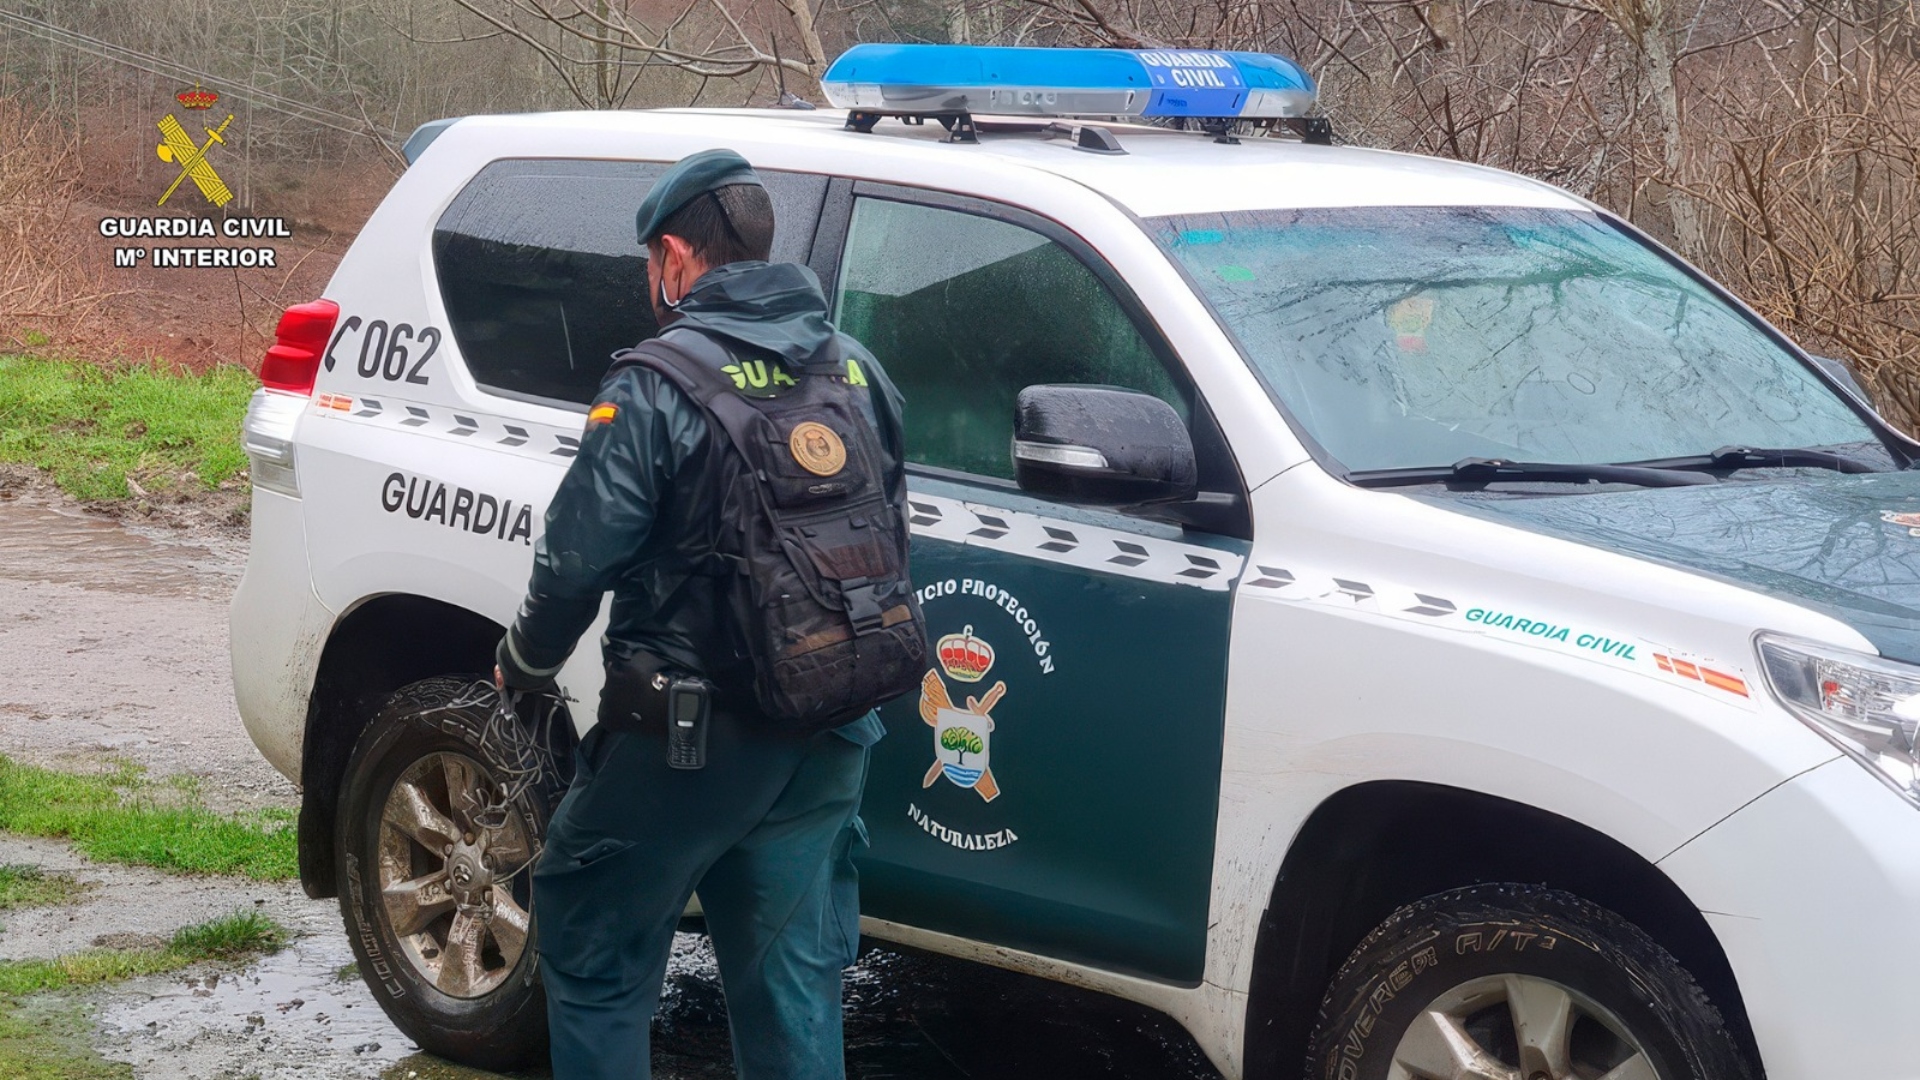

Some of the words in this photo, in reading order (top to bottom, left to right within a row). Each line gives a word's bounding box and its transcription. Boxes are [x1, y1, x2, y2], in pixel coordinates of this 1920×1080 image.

[1139, 52, 1232, 68] GUARDIA
[1171, 69, 1225, 87] CIVIL
[357, 319, 442, 386] 062
[382, 472, 532, 546] GUARDIA
[912, 578, 957, 605] ICIO
[1465, 608, 1570, 643] GUARDIA
[1575, 633, 1637, 661] CIVIL
[907, 802, 1019, 851] NATURALEZA
